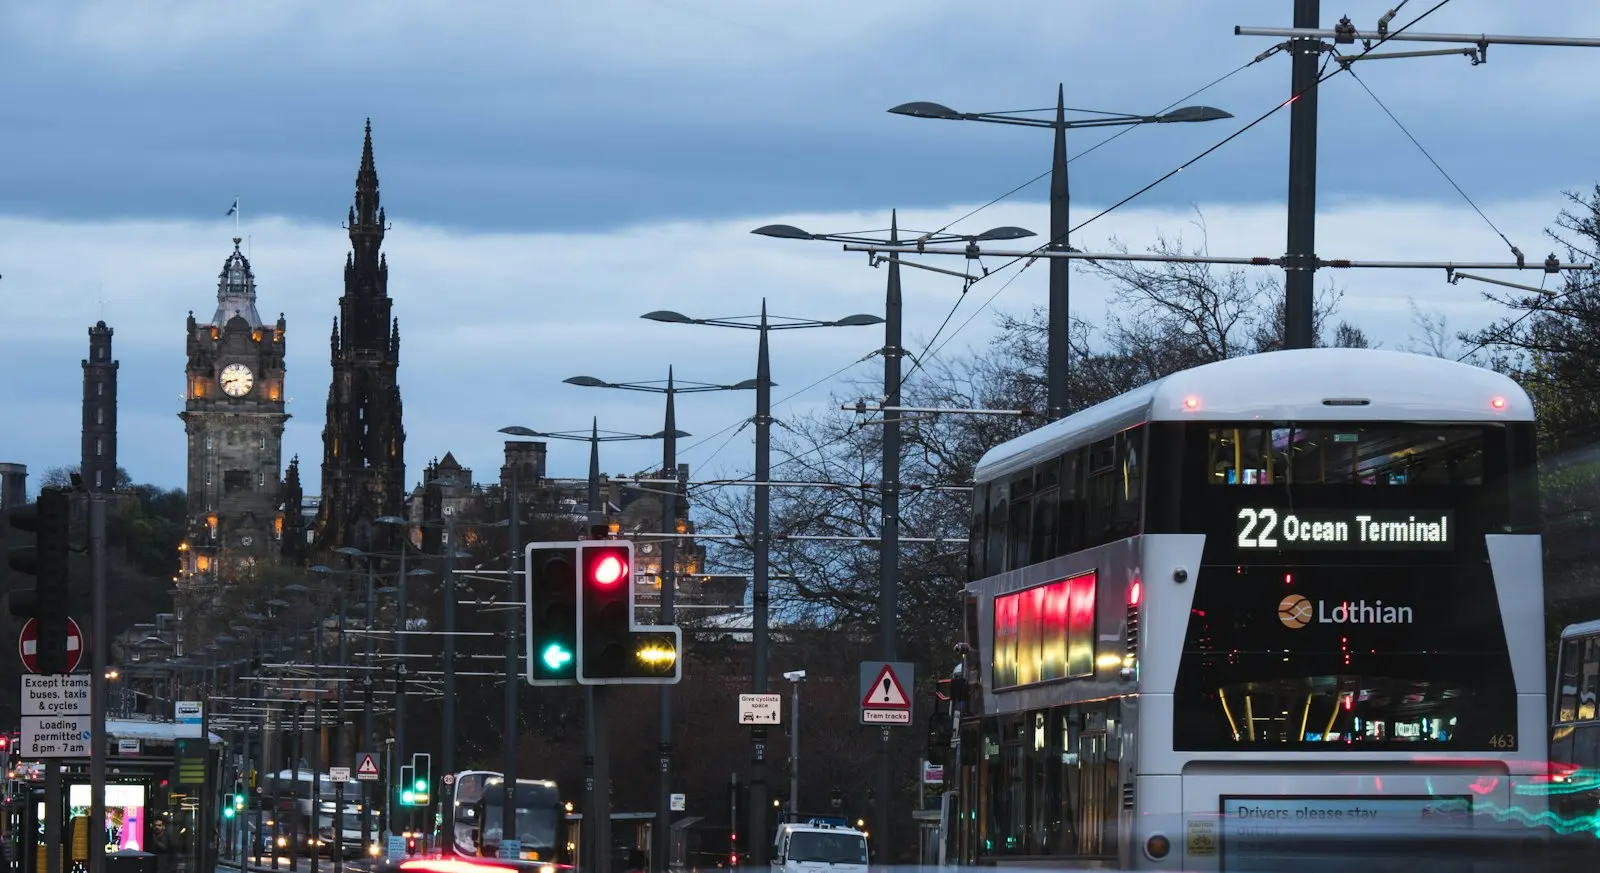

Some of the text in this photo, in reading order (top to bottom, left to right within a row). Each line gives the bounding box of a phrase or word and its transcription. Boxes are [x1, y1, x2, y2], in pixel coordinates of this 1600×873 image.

[1238, 508, 1447, 547] 22 Ocean Terminal
[1318, 600, 1413, 624] Lothian
[25, 678, 58, 689] Except
[64, 690, 87, 698] taxis
[39, 701, 78, 711] & cycles
[40, 720, 77, 731] Loading
[34, 732, 82, 742] permitted
[1489, 735, 1514, 748] 463
[63, 743, 69, 751] 7
[1295, 806, 1343, 821] please
[1346, 807, 1377, 821] stay
